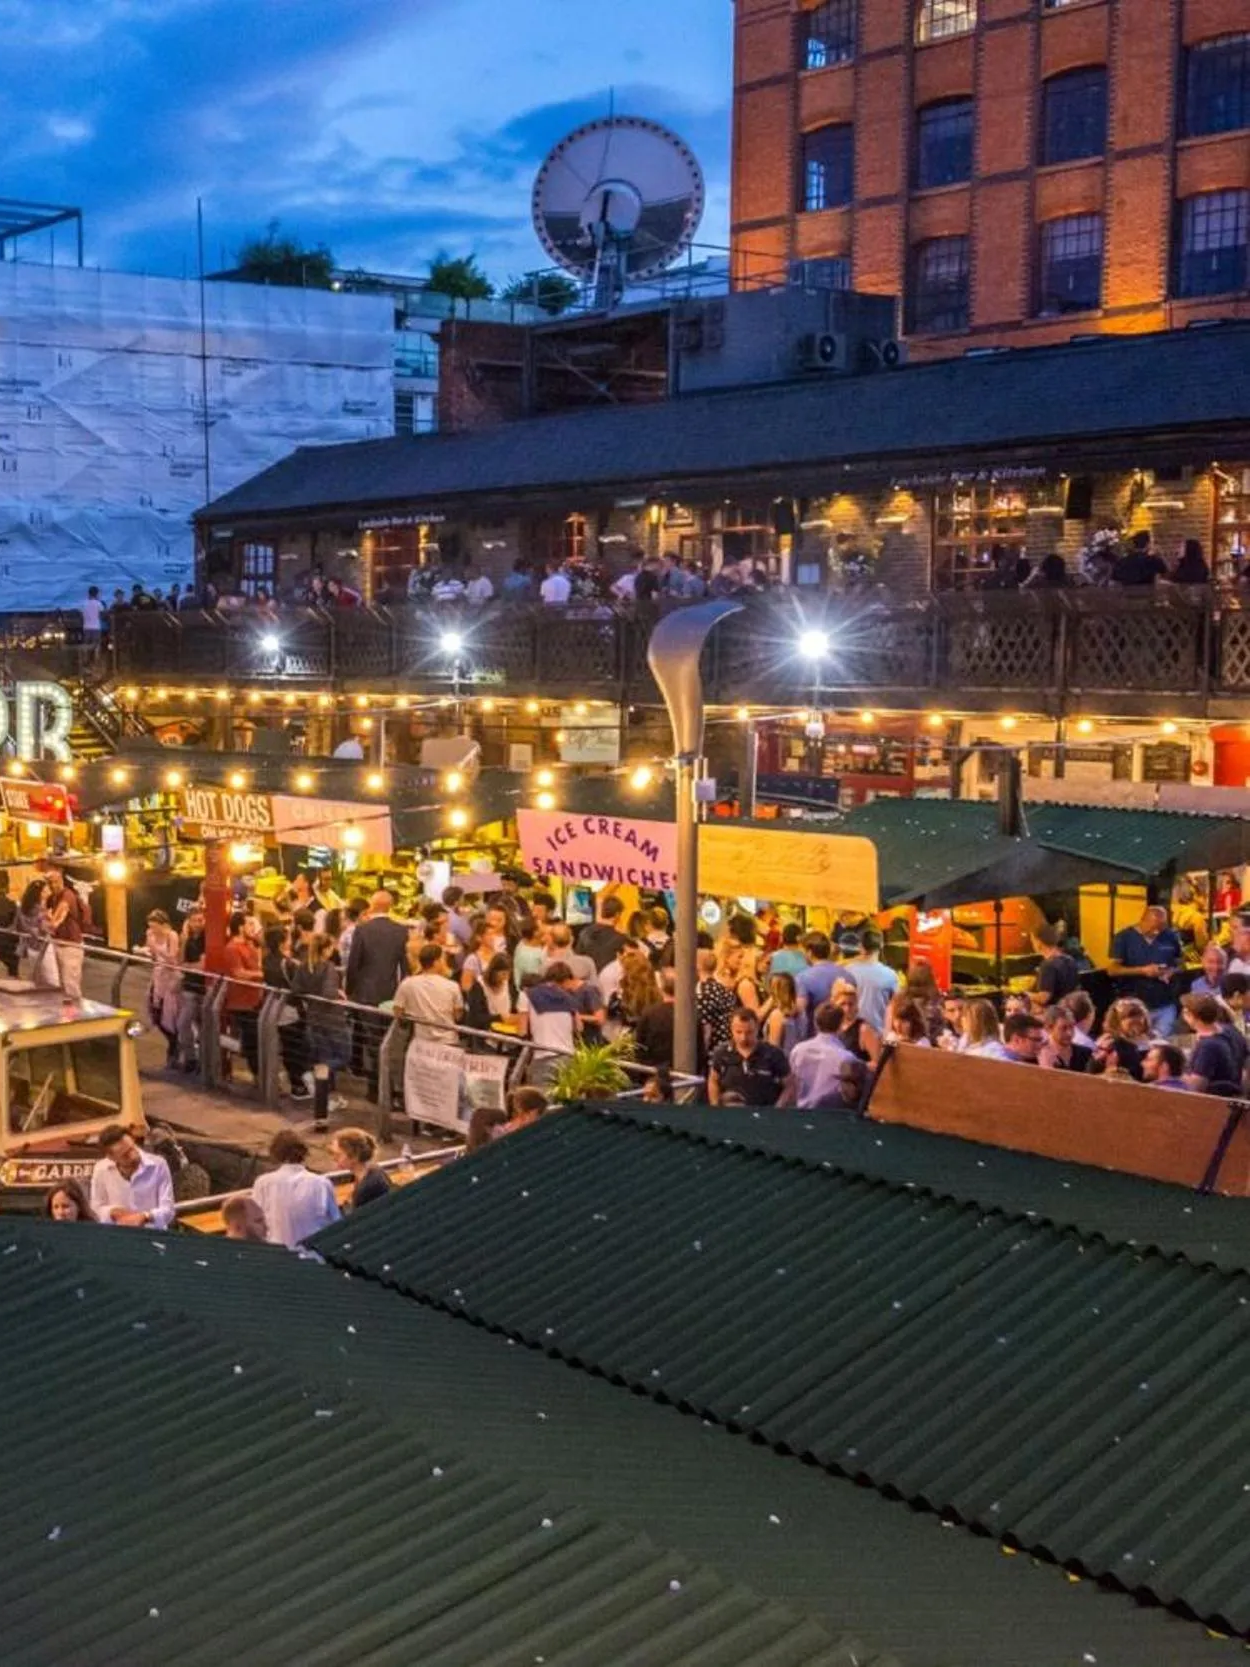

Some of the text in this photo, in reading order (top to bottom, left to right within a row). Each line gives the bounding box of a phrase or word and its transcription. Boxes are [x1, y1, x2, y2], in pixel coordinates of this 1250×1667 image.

[185, 789, 217, 820] HOT
[222, 792, 271, 826] DOGS
[546, 816, 660, 863] ICE CREAM
[532, 856, 678, 889] SANDWICHE
[37, 1163, 92, 1180] GARDE
